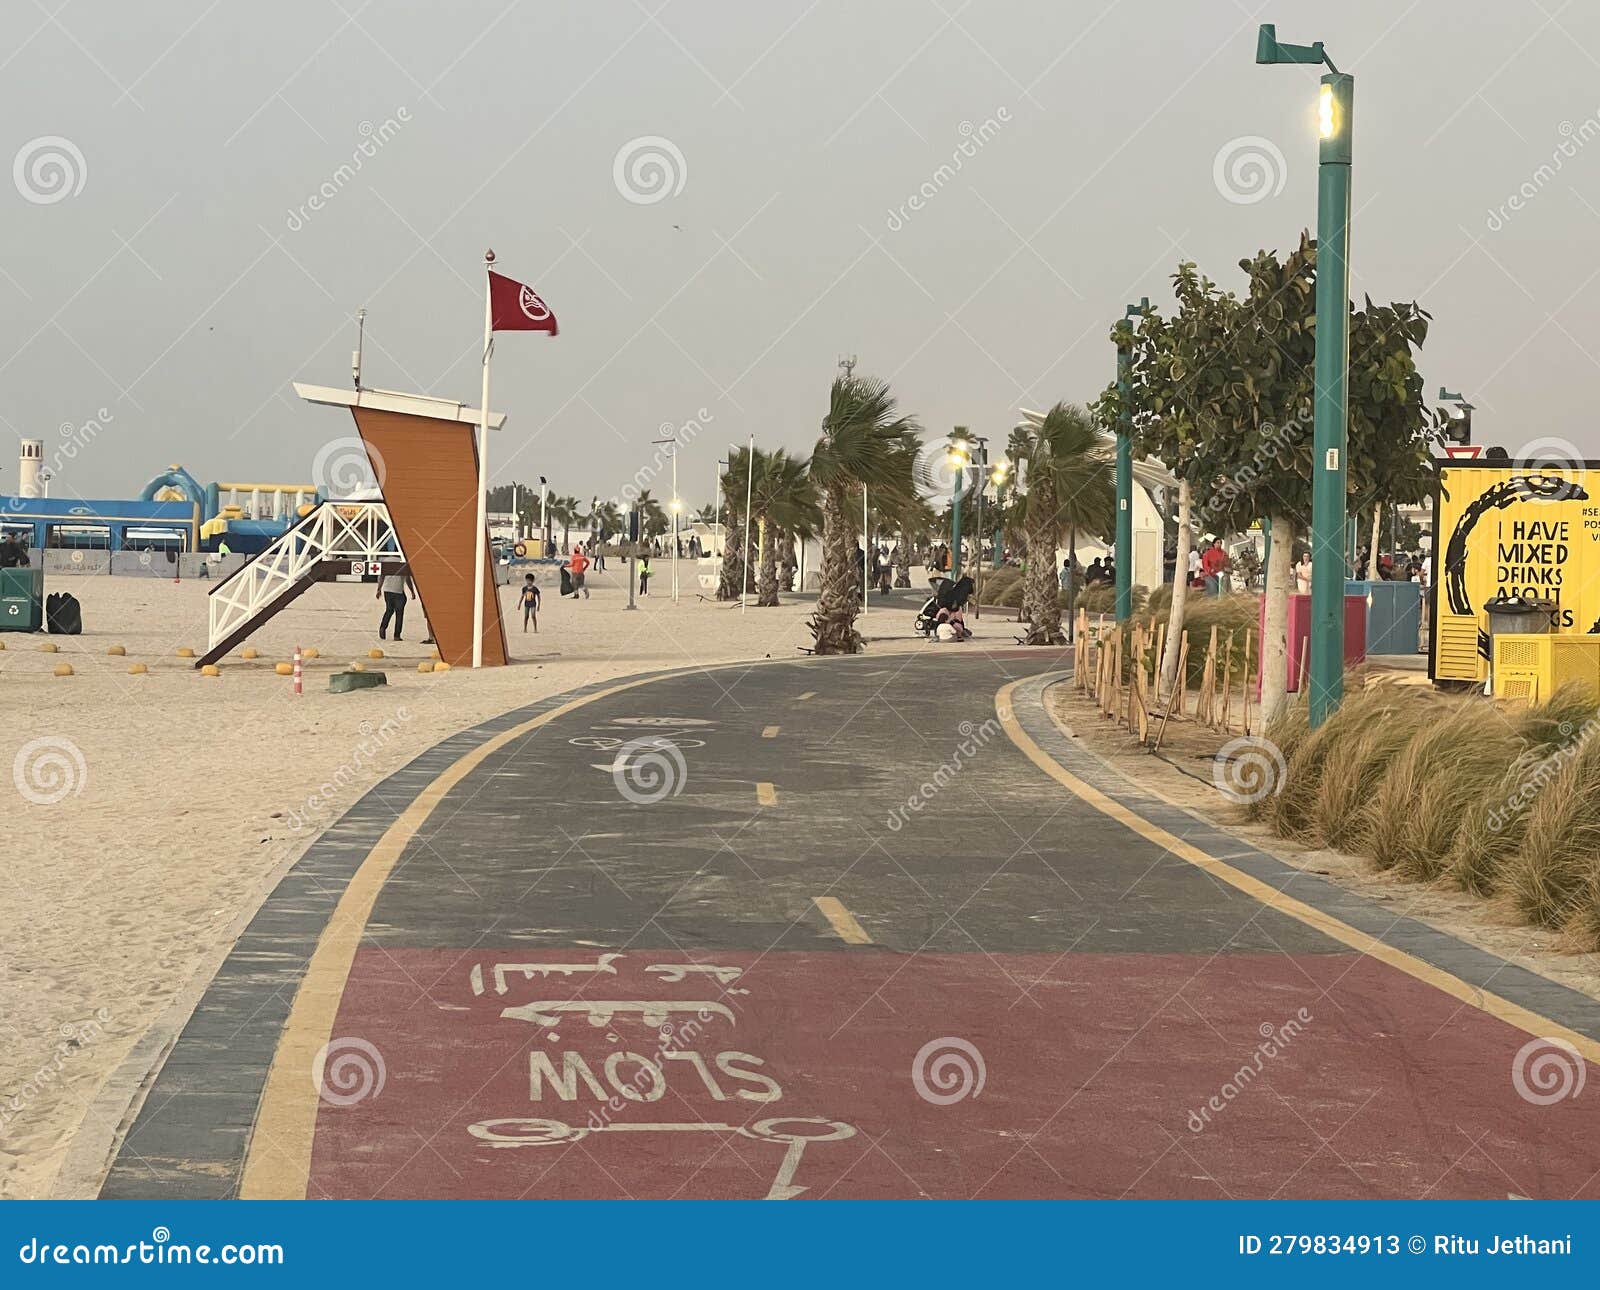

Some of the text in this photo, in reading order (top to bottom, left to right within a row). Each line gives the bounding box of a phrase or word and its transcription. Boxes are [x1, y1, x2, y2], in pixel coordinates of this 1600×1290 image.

[1582, 507, 1600, 517] #SE
[1513, 521, 1569, 541] HAVE
[1498, 543, 1568, 564] MIXED
[1497, 566, 1563, 585] DRINKS
[529, 1050, 783, 1102] SLOW
